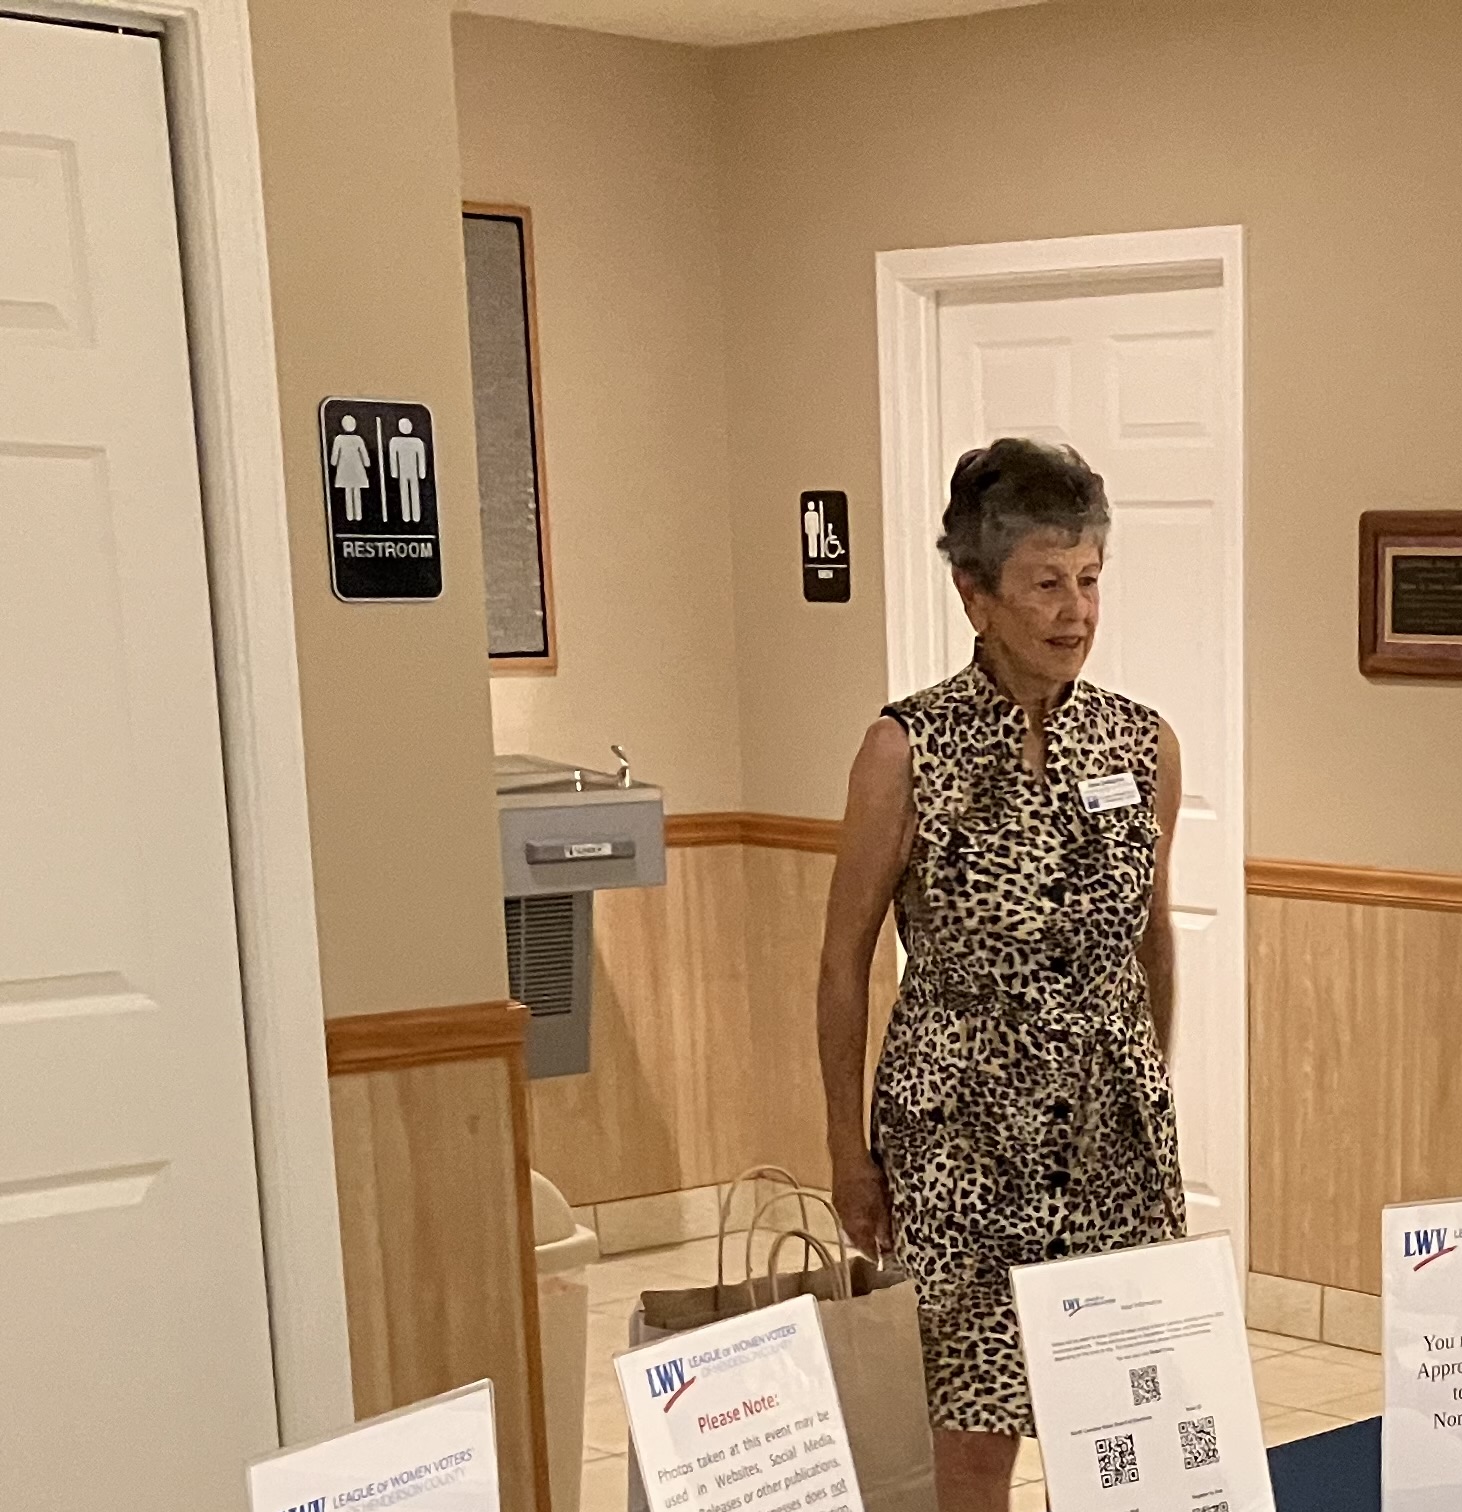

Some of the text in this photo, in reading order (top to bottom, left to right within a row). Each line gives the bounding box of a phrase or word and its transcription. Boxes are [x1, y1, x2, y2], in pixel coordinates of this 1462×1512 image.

[342, 541, 433, 558] RESTROOM
[1404, 1228, 1447, 1257] LWV
[1423, 1334, 1455, 1352] You
[646, 1358, 685, 1398] LWV
[688, 1347, 720, 1368] LEAGUE
[732, 1335, 764, 1354] WOMEN
[698, 1393, 779, 1434] Please Note:
[658, 1410, 830, 1484] Photos taken at this event may be
[333, 1482, 374, 1510] LEAGUE
[390, 1463, 432, 1489] WOMEN
[433, 1448, 473, 1473] VOTERS
[664, 1488, 689, 1509] used
[697, 1482, 708, 1496] in
[714, 1462, 763, 1490] Websites,
[769, 1445, 797, 1468] Social
[743, 1491, 754, 1504] or
[756, 1479, 782, 1499] other
[805, 1486, 828, 1505] does
[830, 1478, 848, 1498] not
